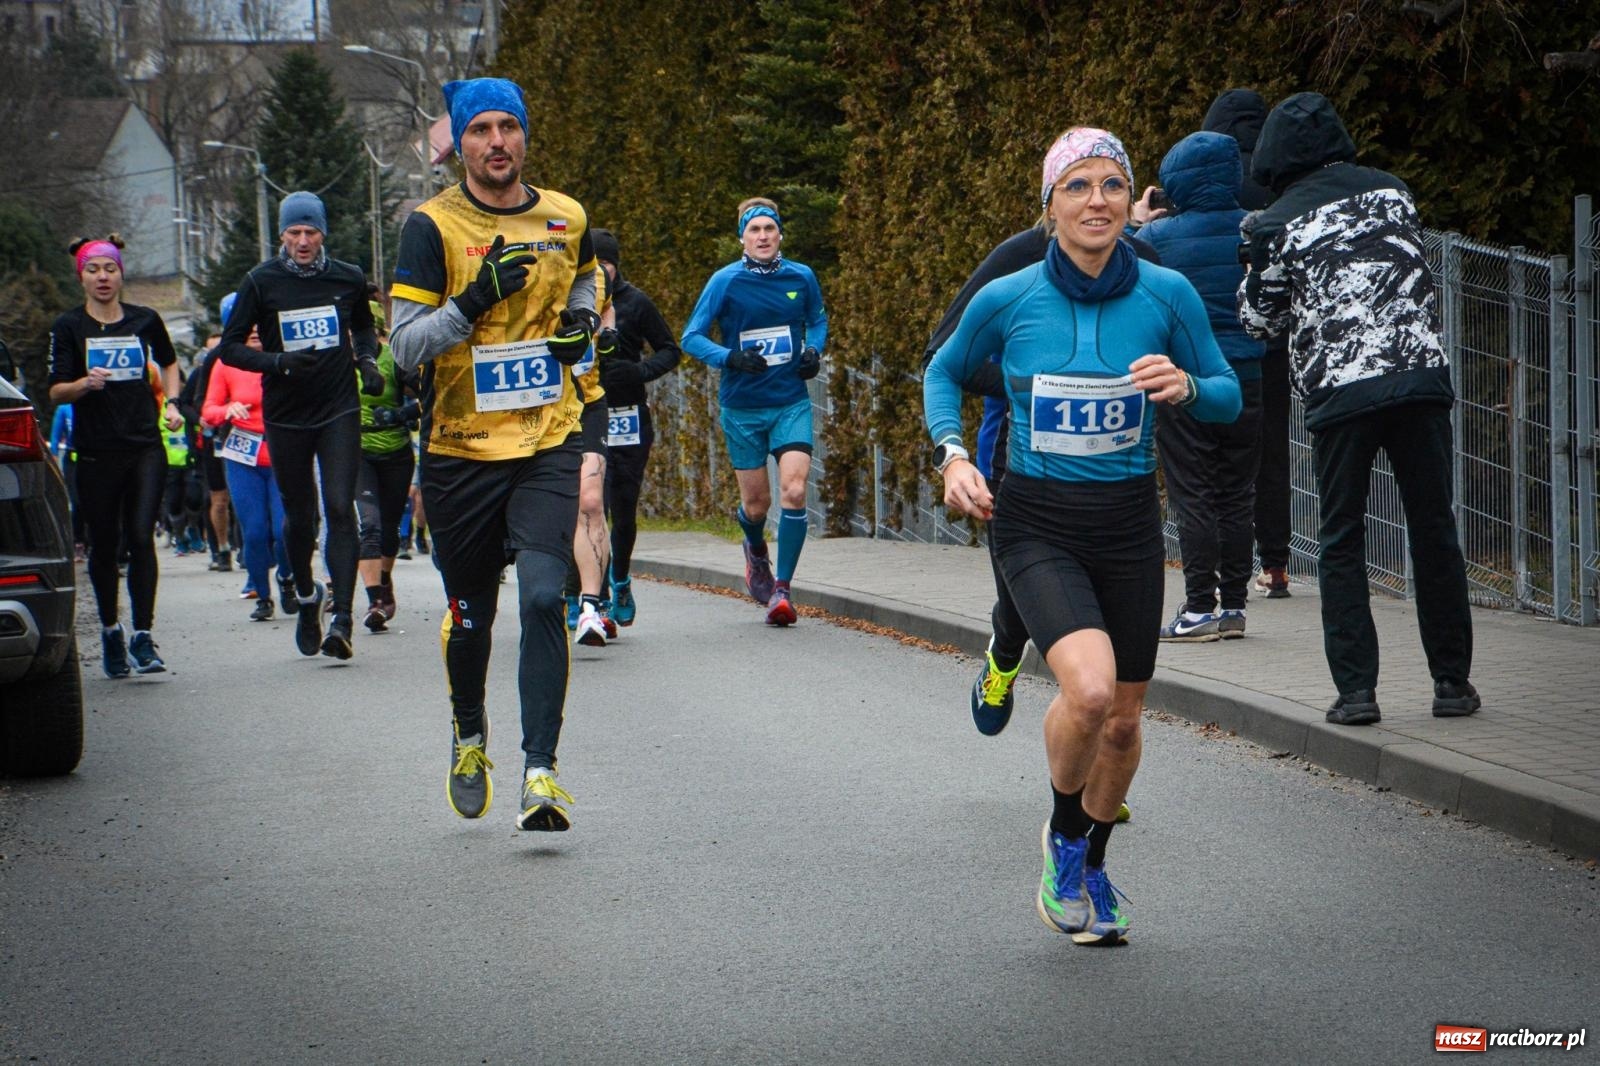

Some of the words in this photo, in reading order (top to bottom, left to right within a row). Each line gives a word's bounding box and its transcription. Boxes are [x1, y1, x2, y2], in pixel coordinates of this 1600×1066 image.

[529, 241, 566, 251] TEAM
[291, 319, 330, 339] 188
[103, 349, 130, 367] 76
[491, 358, 549, 390] 113
[1054, 400, 1126, 432] 118
[228, 434, 252, 453] 138
